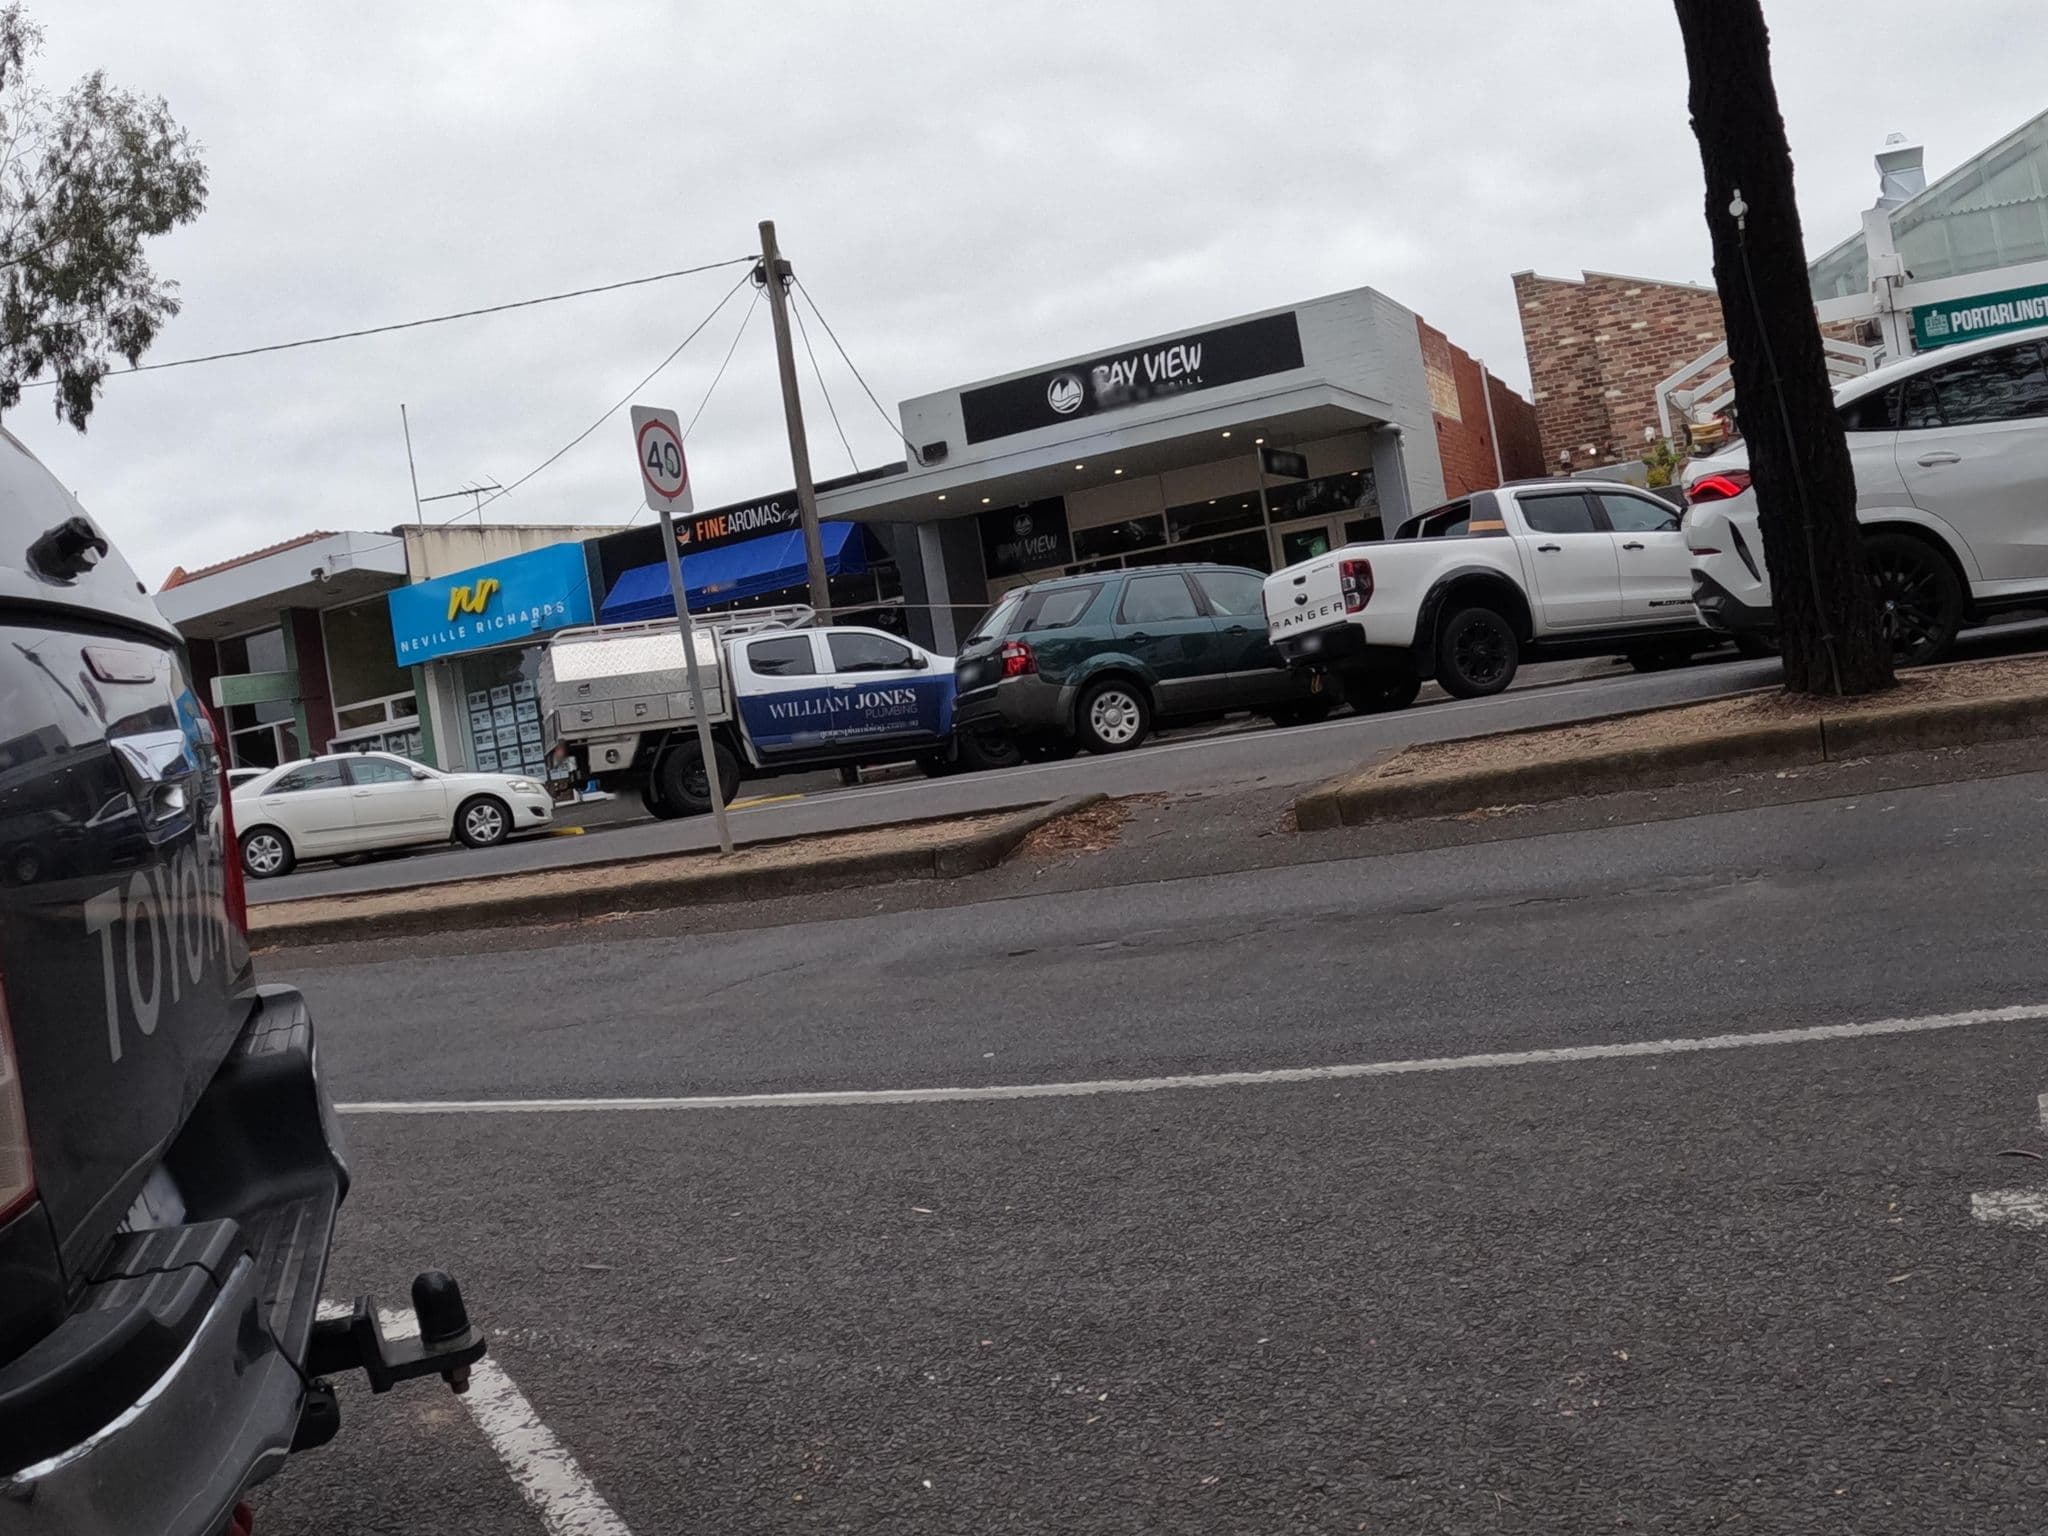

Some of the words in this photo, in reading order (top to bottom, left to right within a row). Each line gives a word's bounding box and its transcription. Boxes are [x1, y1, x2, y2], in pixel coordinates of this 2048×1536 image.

[1144, 343, 1202, 382] VIEW
[647, 441, 681, 478] 40
[1024, 533, 1057, 555] VIEW
[401, 627, 466, 653] NEVILLE
[476, 601, 565, 634] RICHARDS
[1272, 602, 1343, 631] RANGER
[769, 695, 850, 719] WILLIAM
[855, 688, 916, 710] JONES
[865, 704, 918, 719] PLUMBING
[84, 845, 222, 1063] TOYOT
